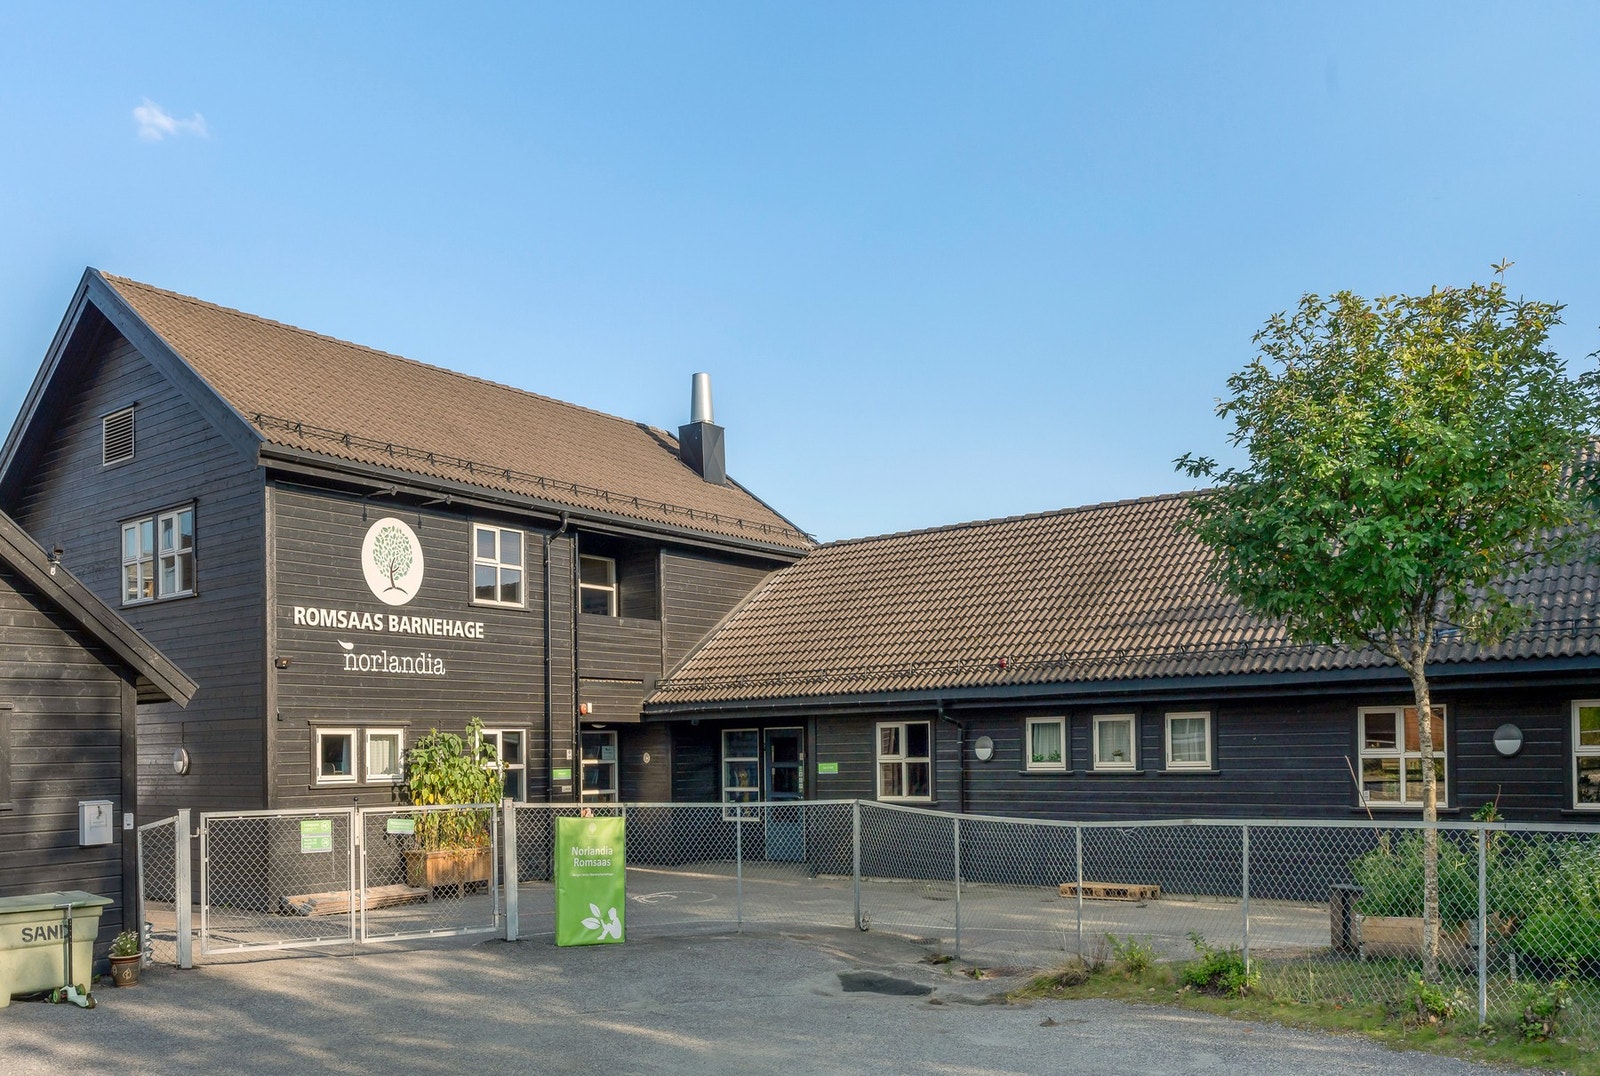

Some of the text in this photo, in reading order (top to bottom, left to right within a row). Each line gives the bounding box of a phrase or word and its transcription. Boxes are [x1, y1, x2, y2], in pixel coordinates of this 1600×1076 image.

[293, 606, 485, 639] ROMSAAS BARNEHAGE
[343, 650, 446, 676] norlandia
[571, 846, 613, 856] Norlandia
[573, 857, 611, 867] Romsaas
[21, 924, 69, 943] SAND
